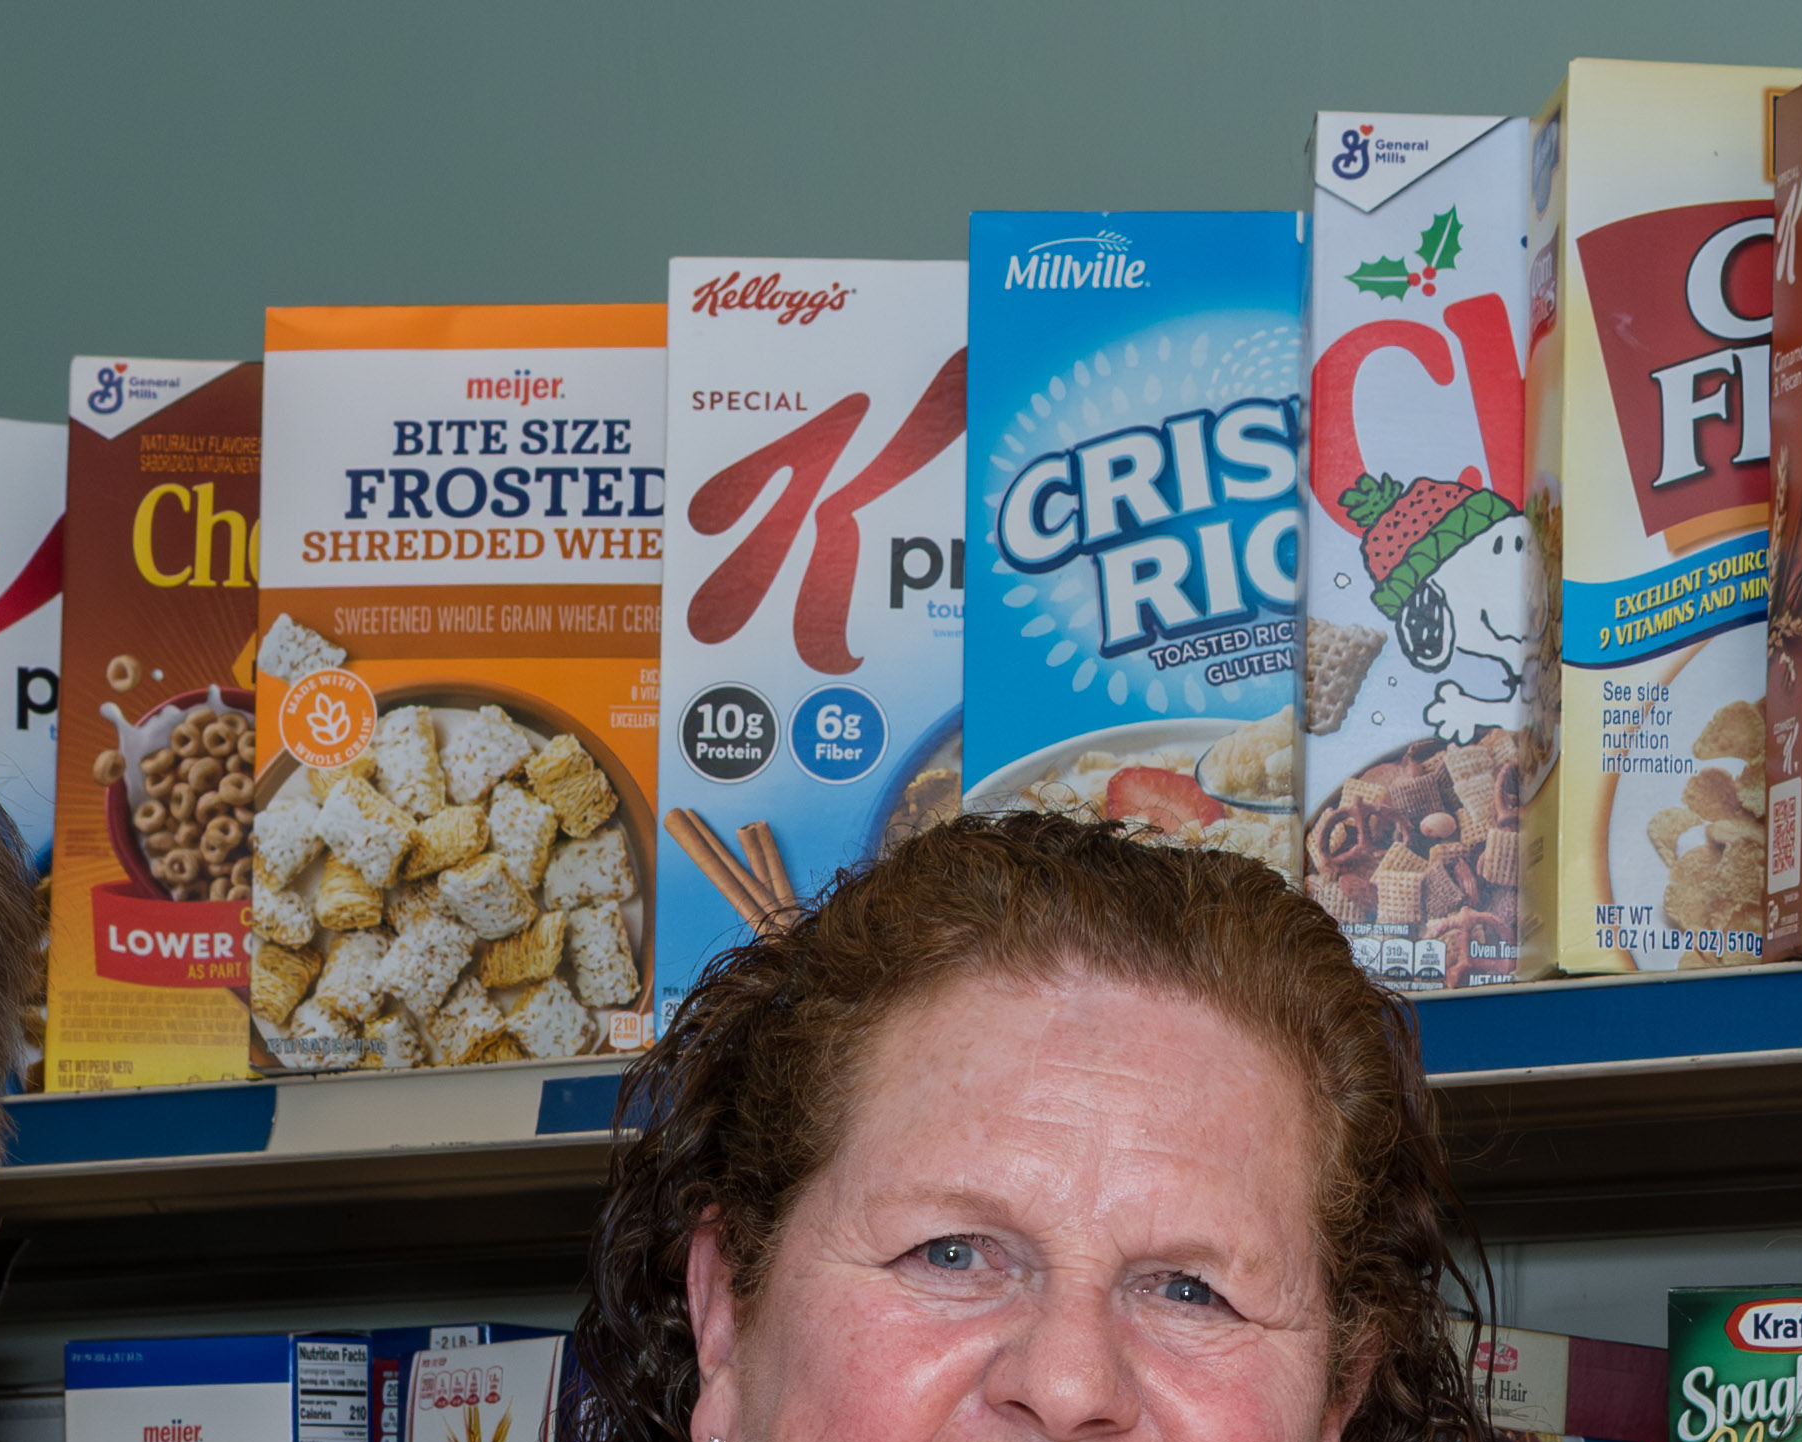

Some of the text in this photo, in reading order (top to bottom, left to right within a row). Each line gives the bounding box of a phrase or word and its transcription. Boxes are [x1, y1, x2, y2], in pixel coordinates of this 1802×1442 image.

[1375, 139, 1429, 151] General
[1375, 153, 1406, 164] Mills
[1004, 254, 1146, 290] Millville
[691, 271, 851, 326] Kellogg's
[129, 376, 180, 388] General
[129, 388, 157, 399] Mills
[692, 391, 808, 412] SPECIAL
[393, 418, 632, 456] BITE SIZE
[344, 466, 666, 520] FROSTED
[302, 528, 545, 563] SHREDDED
[1614, 566, 1705, 620] EXCELLENT
[334, 604, 617, 635] SWEETENED WHOLE GRAIN WHEAT
[1599, 585, 1736, 650] 9 VITAMINS AND
[1151, 633, 1250, 670] TOASTED
[319, 674, 357, 693] WITH
[1206, 657, 1292, 687] GLUTEN
[1602, 680, 1670, 702] See side
[696, 702, 765, 741] 10g
[815, 703, 863, 741] 6g
[1602, 705, 1673, 729] panel for
[695, 741, 763, 760] Protein
[814, 742, 863, 761] Fiber
[1602, 731, 1670, 751] nutrition
[1601, 753, 1699, 775] information.
[1595, 904, 1654, 926] NET WT
[108, 924, 235, 959] LOWER
[1595, 929, 1764, 956] 18 OZ (1 LB 2 OZ) 510g
